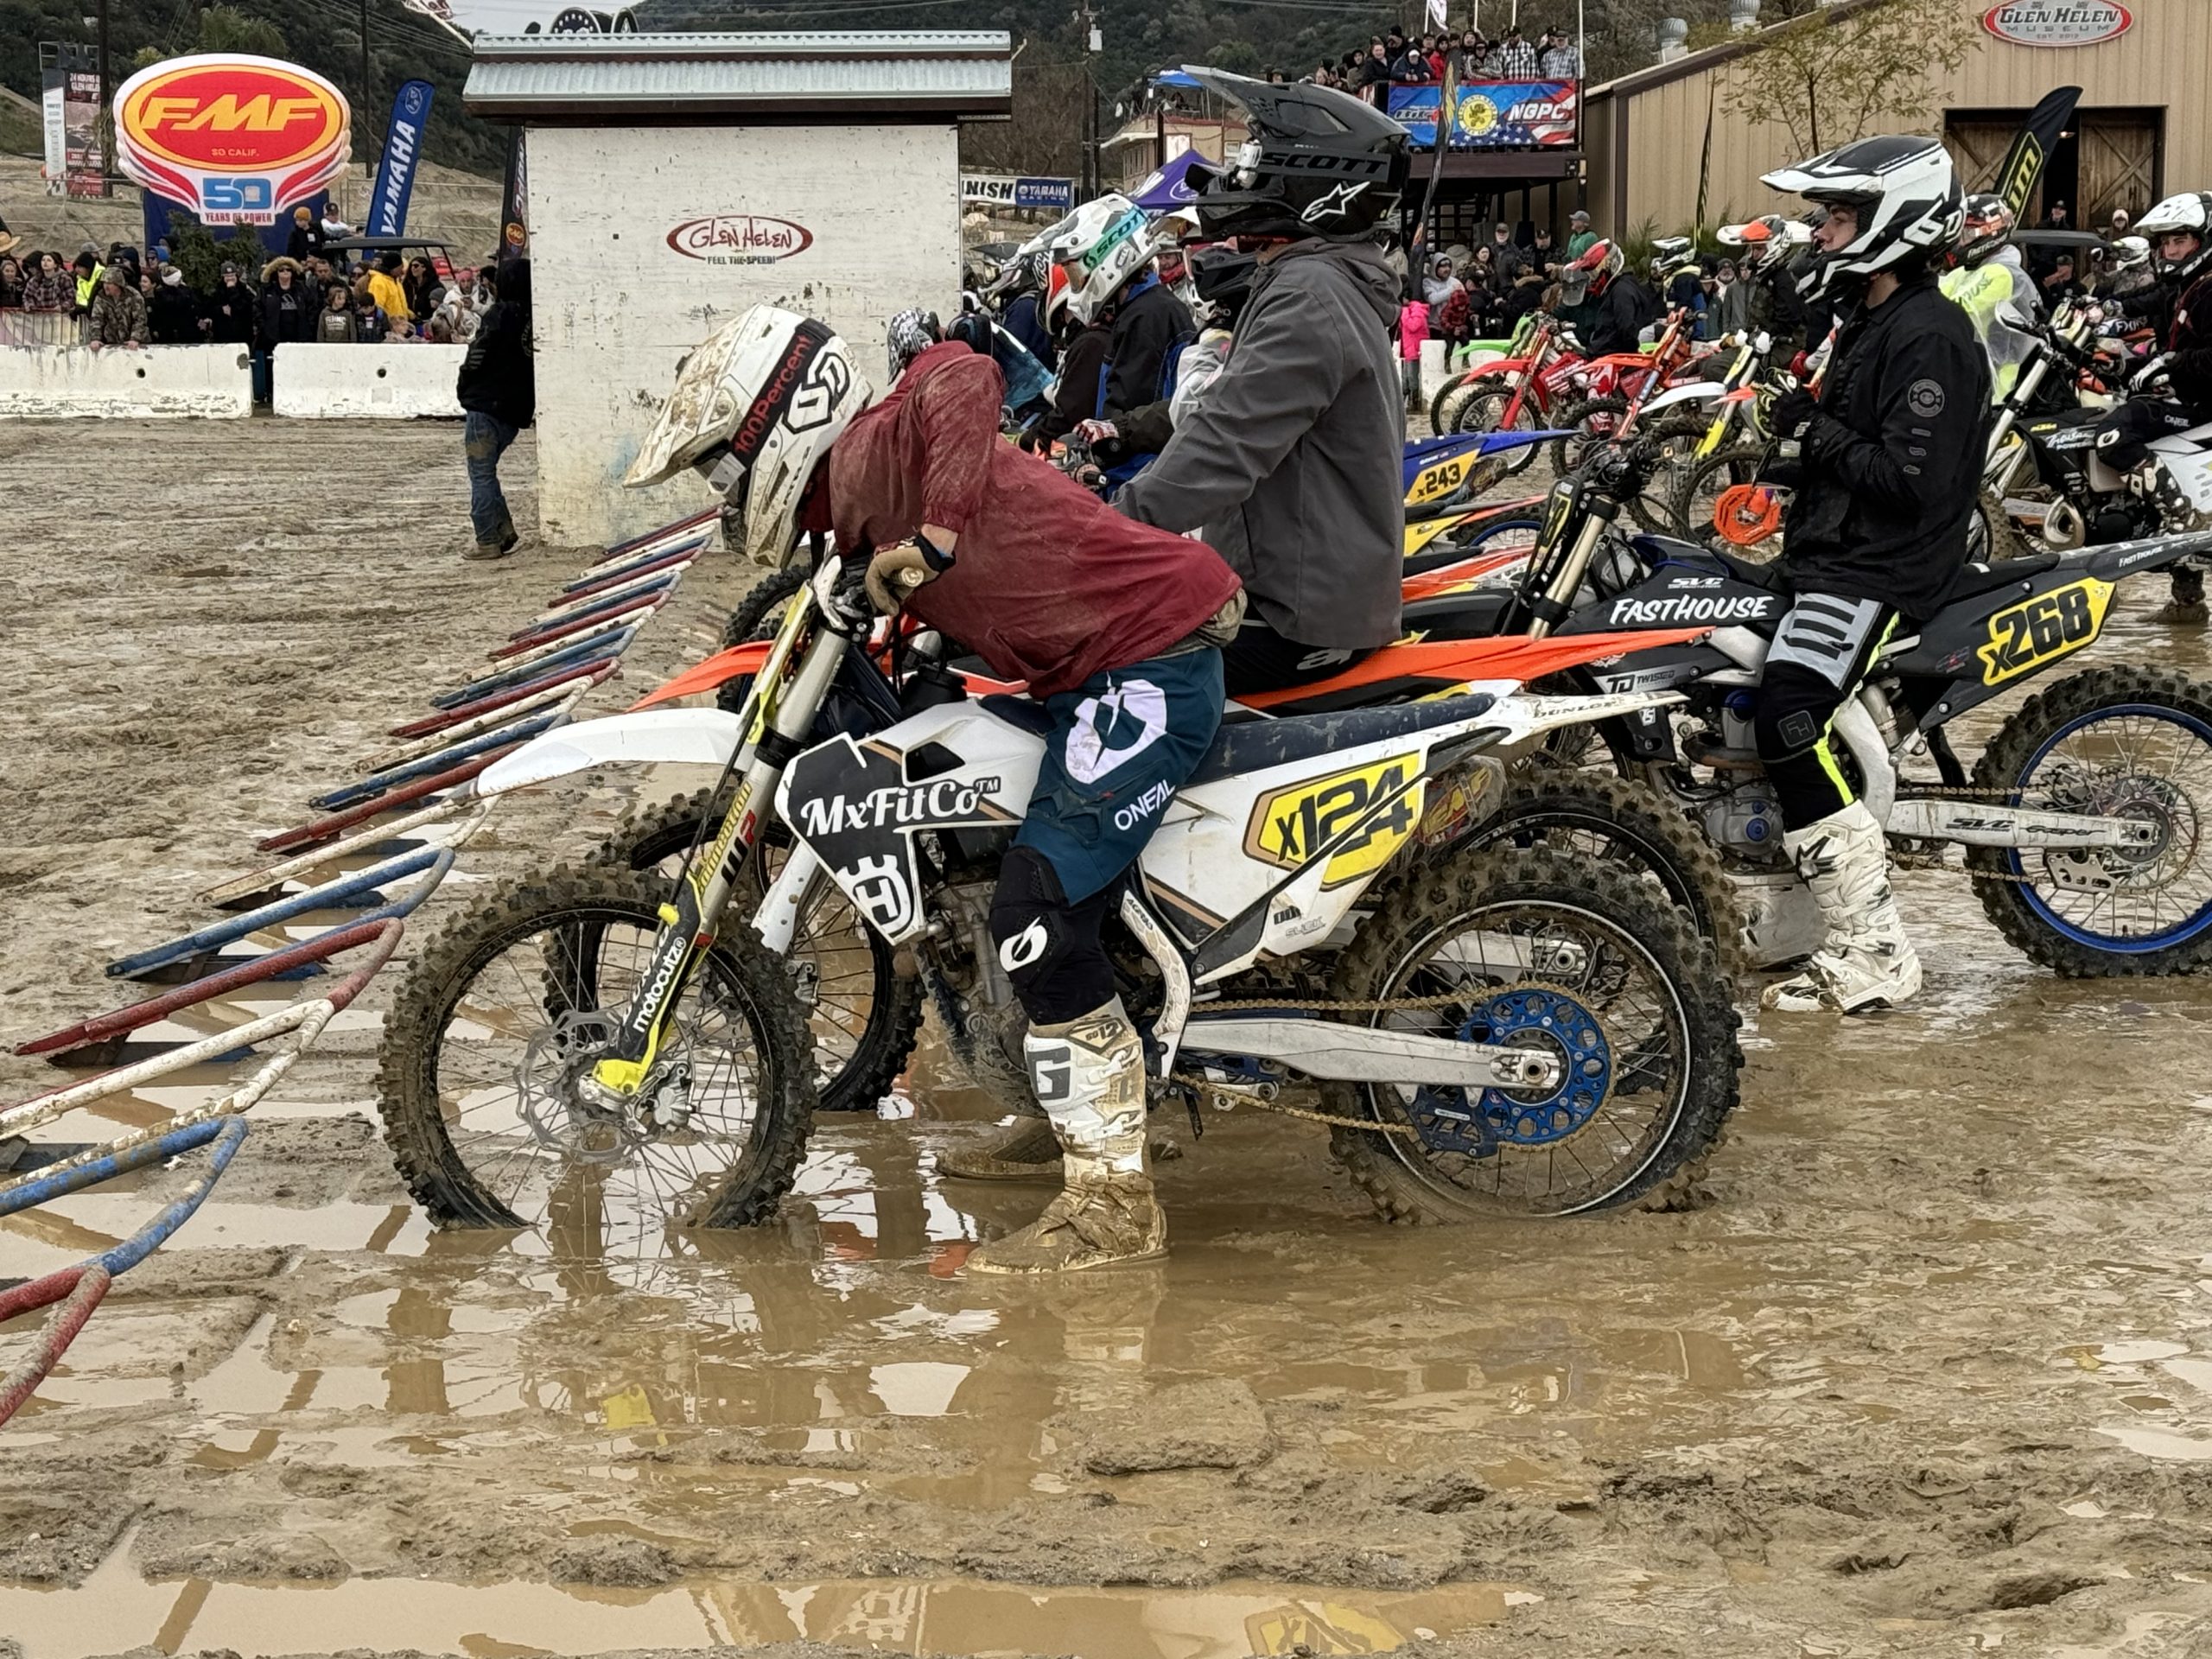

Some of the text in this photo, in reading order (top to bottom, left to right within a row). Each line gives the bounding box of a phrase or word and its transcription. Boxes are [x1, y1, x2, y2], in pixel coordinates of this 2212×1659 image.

[1999, 7, 2119, 23] GLEN HELEN
[140, 94, 322, 130] FMF
[1509, 102, 1567, 121] NGPC
[212, 148, 259, 156] SO CALIF.
[1260, 152, 1388, 175] SCOTT
[381, 119, 416, 235] YAMAHA
[203, 178, 271, 209] 50
[962, 180, 1068, 200] NISH YAMAHA
[206, 213, 230, 222] YEARS
[245, 213, 272, 222] POWER
[690, 217, 792, 249] GLEN HELEN
[708, 256, 727, 264] FEEL
[729, 256, 745, 264] THE
[735, 334, 815, 454] 100Percent
[1671, 577, 1725, 586] SVC
[1610, 594, 1774, 625] FASTHOUSE
